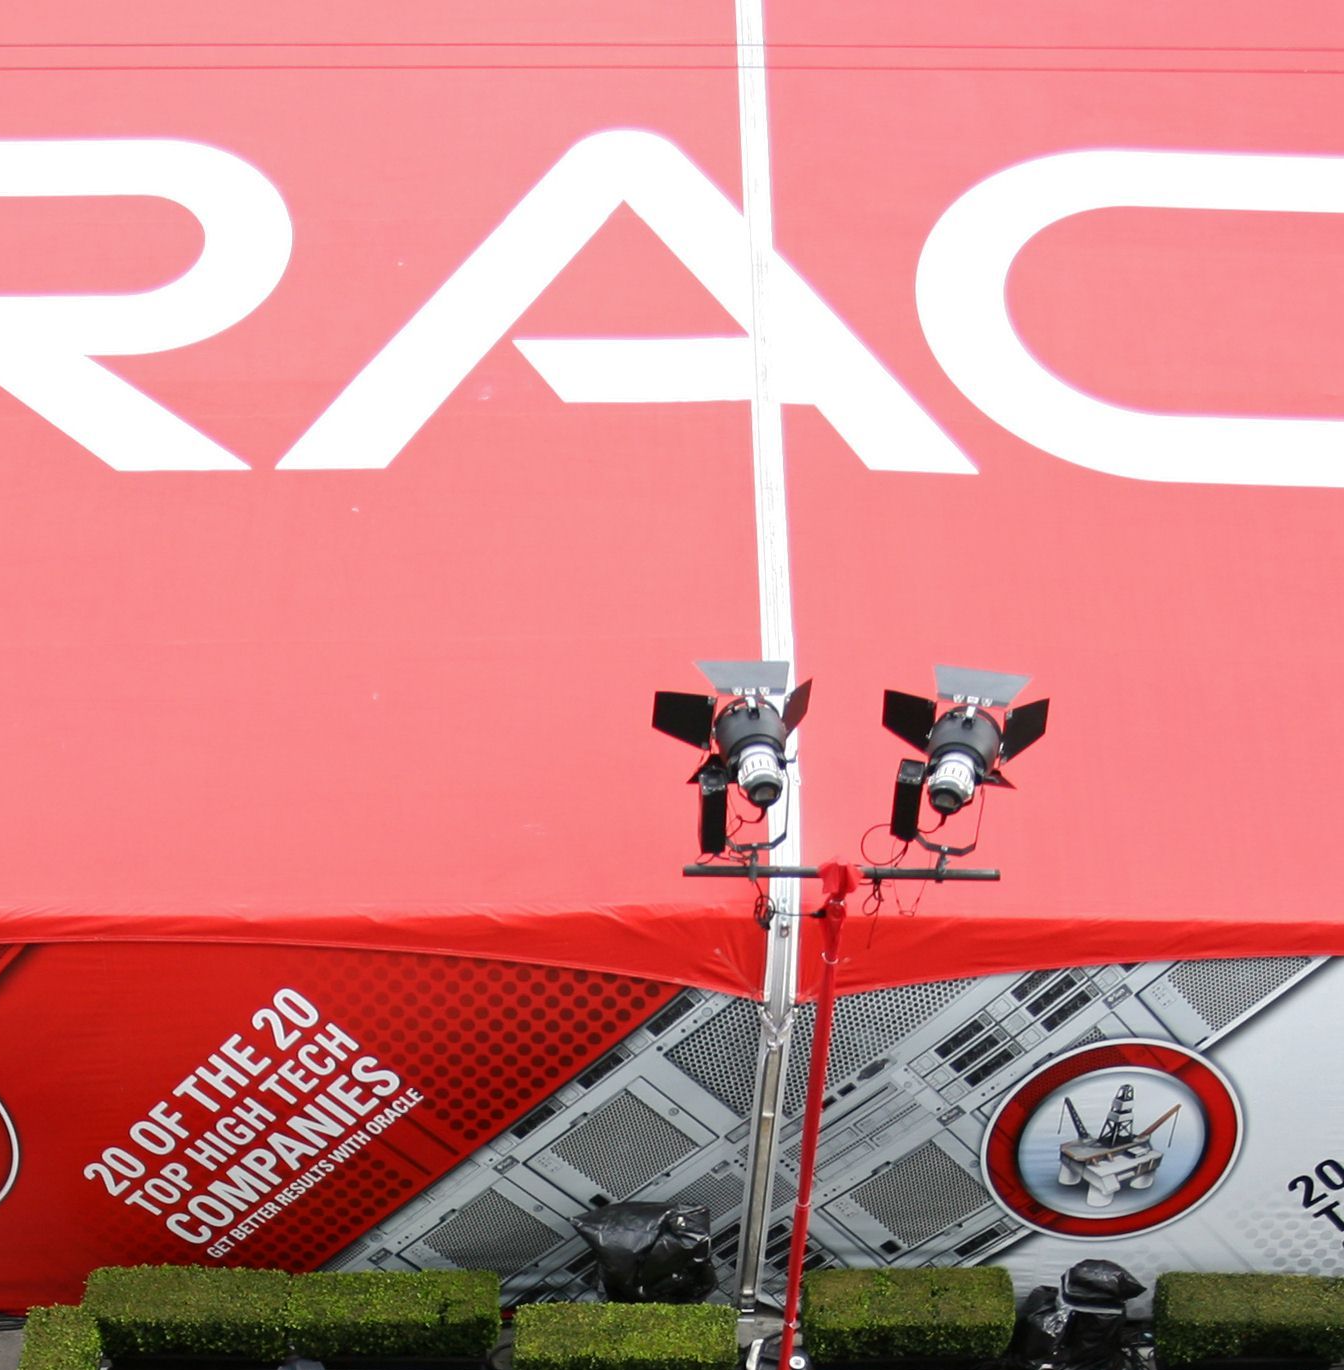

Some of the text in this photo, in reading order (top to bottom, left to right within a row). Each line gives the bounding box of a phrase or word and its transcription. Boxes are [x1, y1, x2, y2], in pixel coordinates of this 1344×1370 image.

[83, 987, 319, 1197] 20 OF THE 20
[124, 1022, 360, 1215] TOP HIGH TECH
[165, 1055, 401, 1245] COMPANIES
[206, 1087, 424, 1258] GET BETTER RESULTS WITH ORACLE
